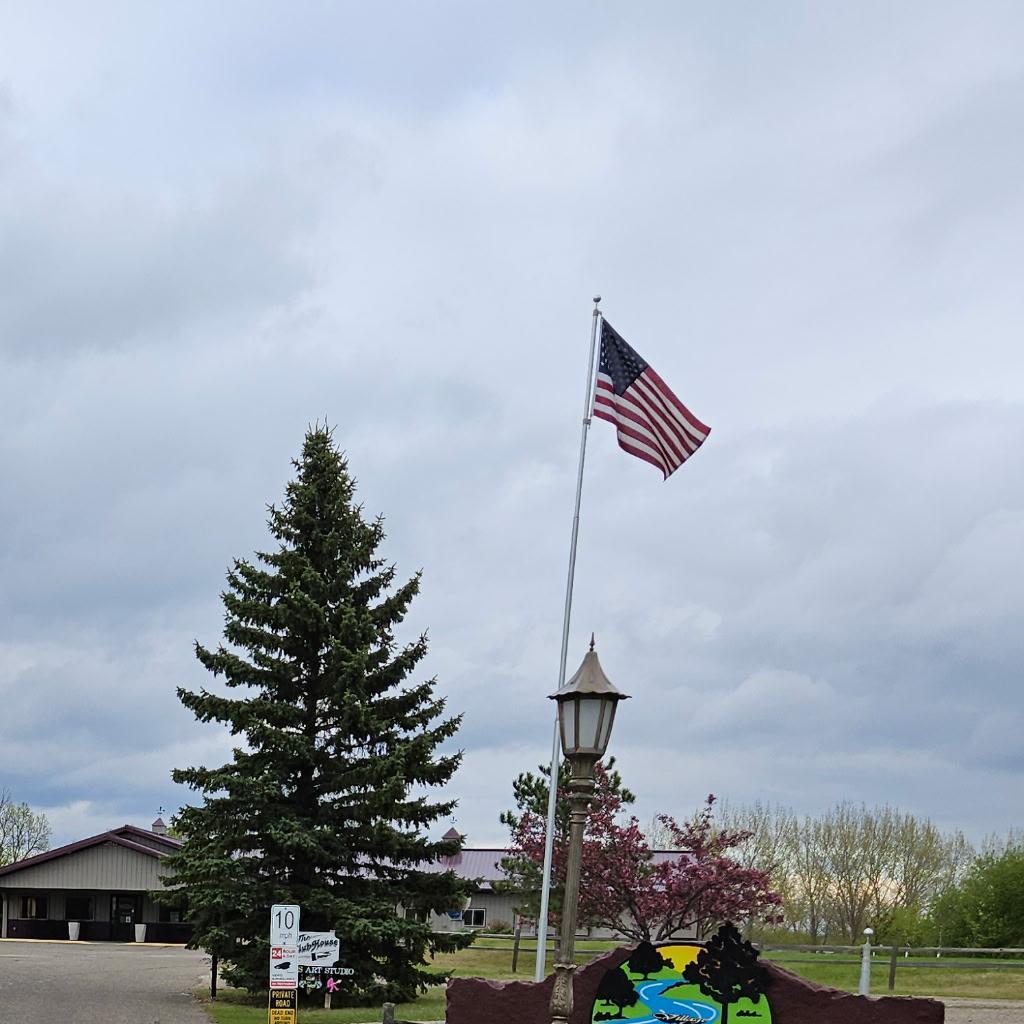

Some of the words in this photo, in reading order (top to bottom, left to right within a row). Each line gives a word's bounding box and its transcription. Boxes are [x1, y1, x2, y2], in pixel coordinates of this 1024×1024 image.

[275, 910, 294, 930] 10
[272, 949, 282, 958] 24
[305, 966, 323, 974] ART
[324, 967, 355, 976] STUDIO
[272, 990, 295, 999] PRIVATE
[275, 999, 291, 1008] ROAD
